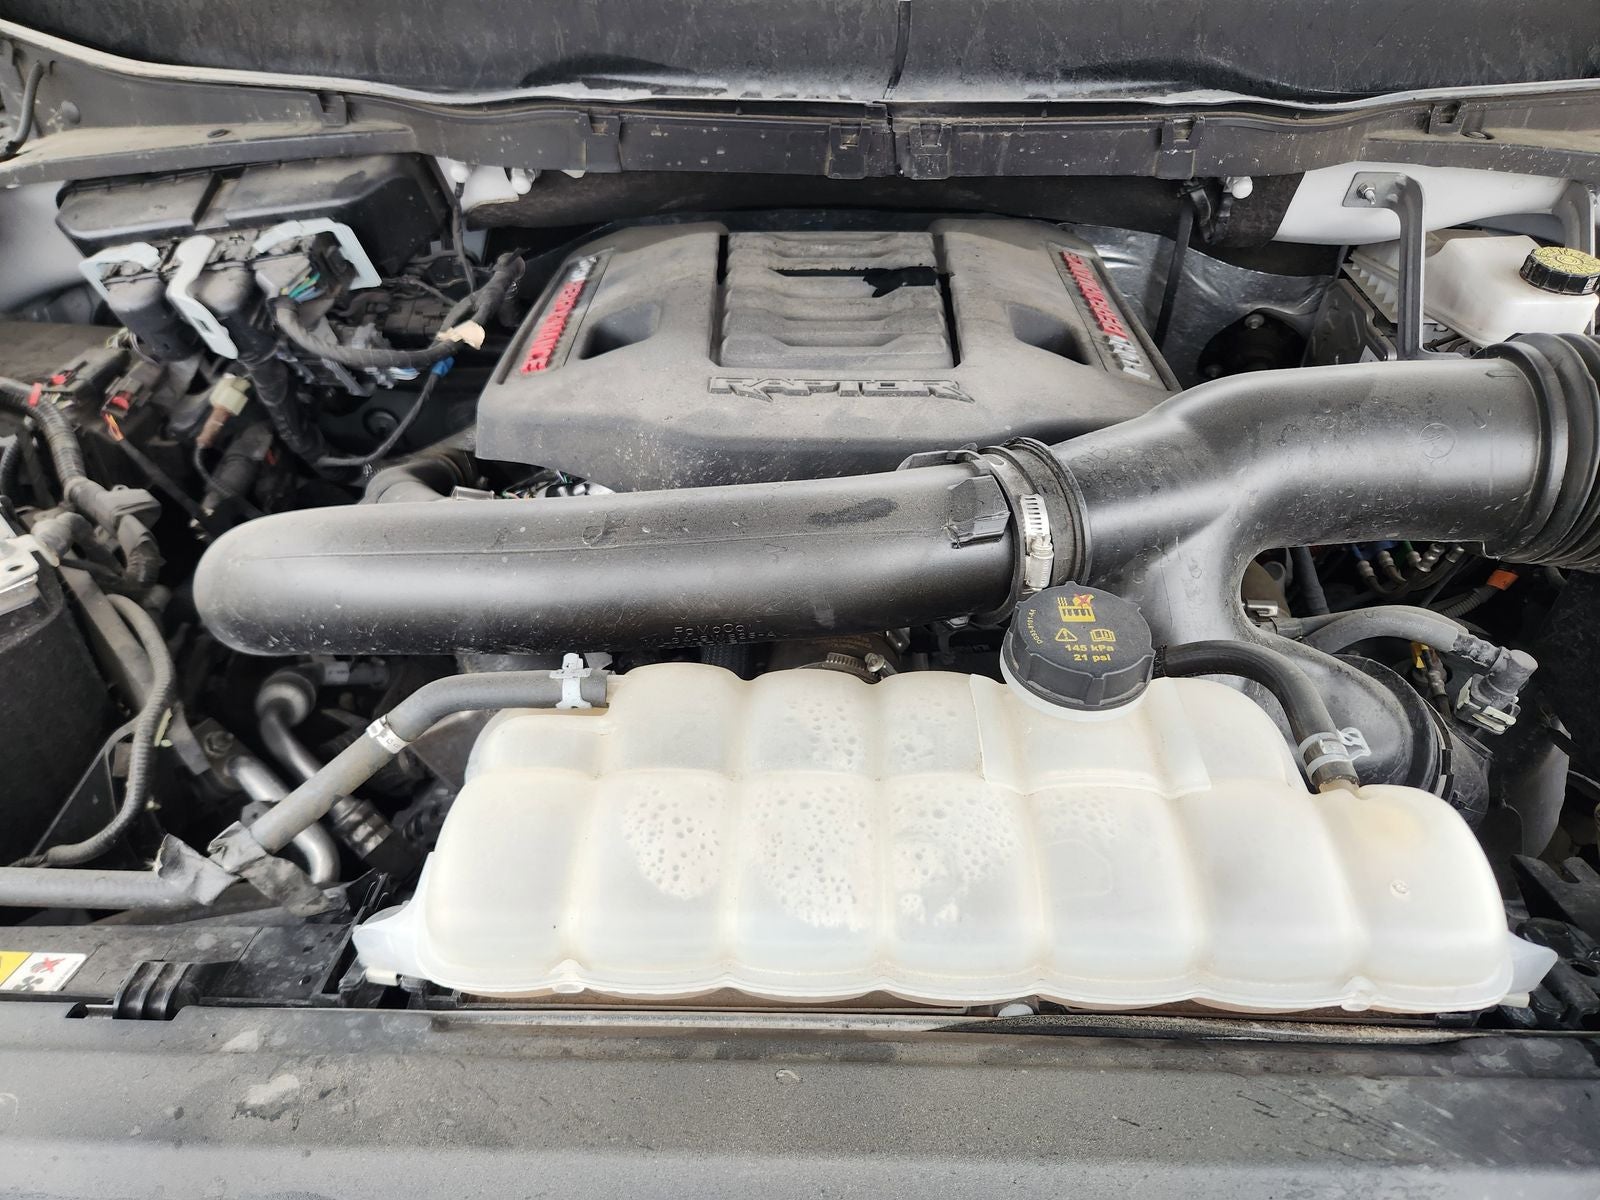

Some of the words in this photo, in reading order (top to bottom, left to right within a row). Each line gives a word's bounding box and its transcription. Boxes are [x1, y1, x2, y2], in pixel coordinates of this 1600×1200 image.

[1060, 250, 1129, 339] PERFORMANCE
[708, 377, 976, 402] RAPTOR
[1065, 644, 1088, 652] 145
[1090, 644, 1115, 652] kPa
[1073, 653, 1089, 662] 21
[1092, 653, 1112, 663] psi
